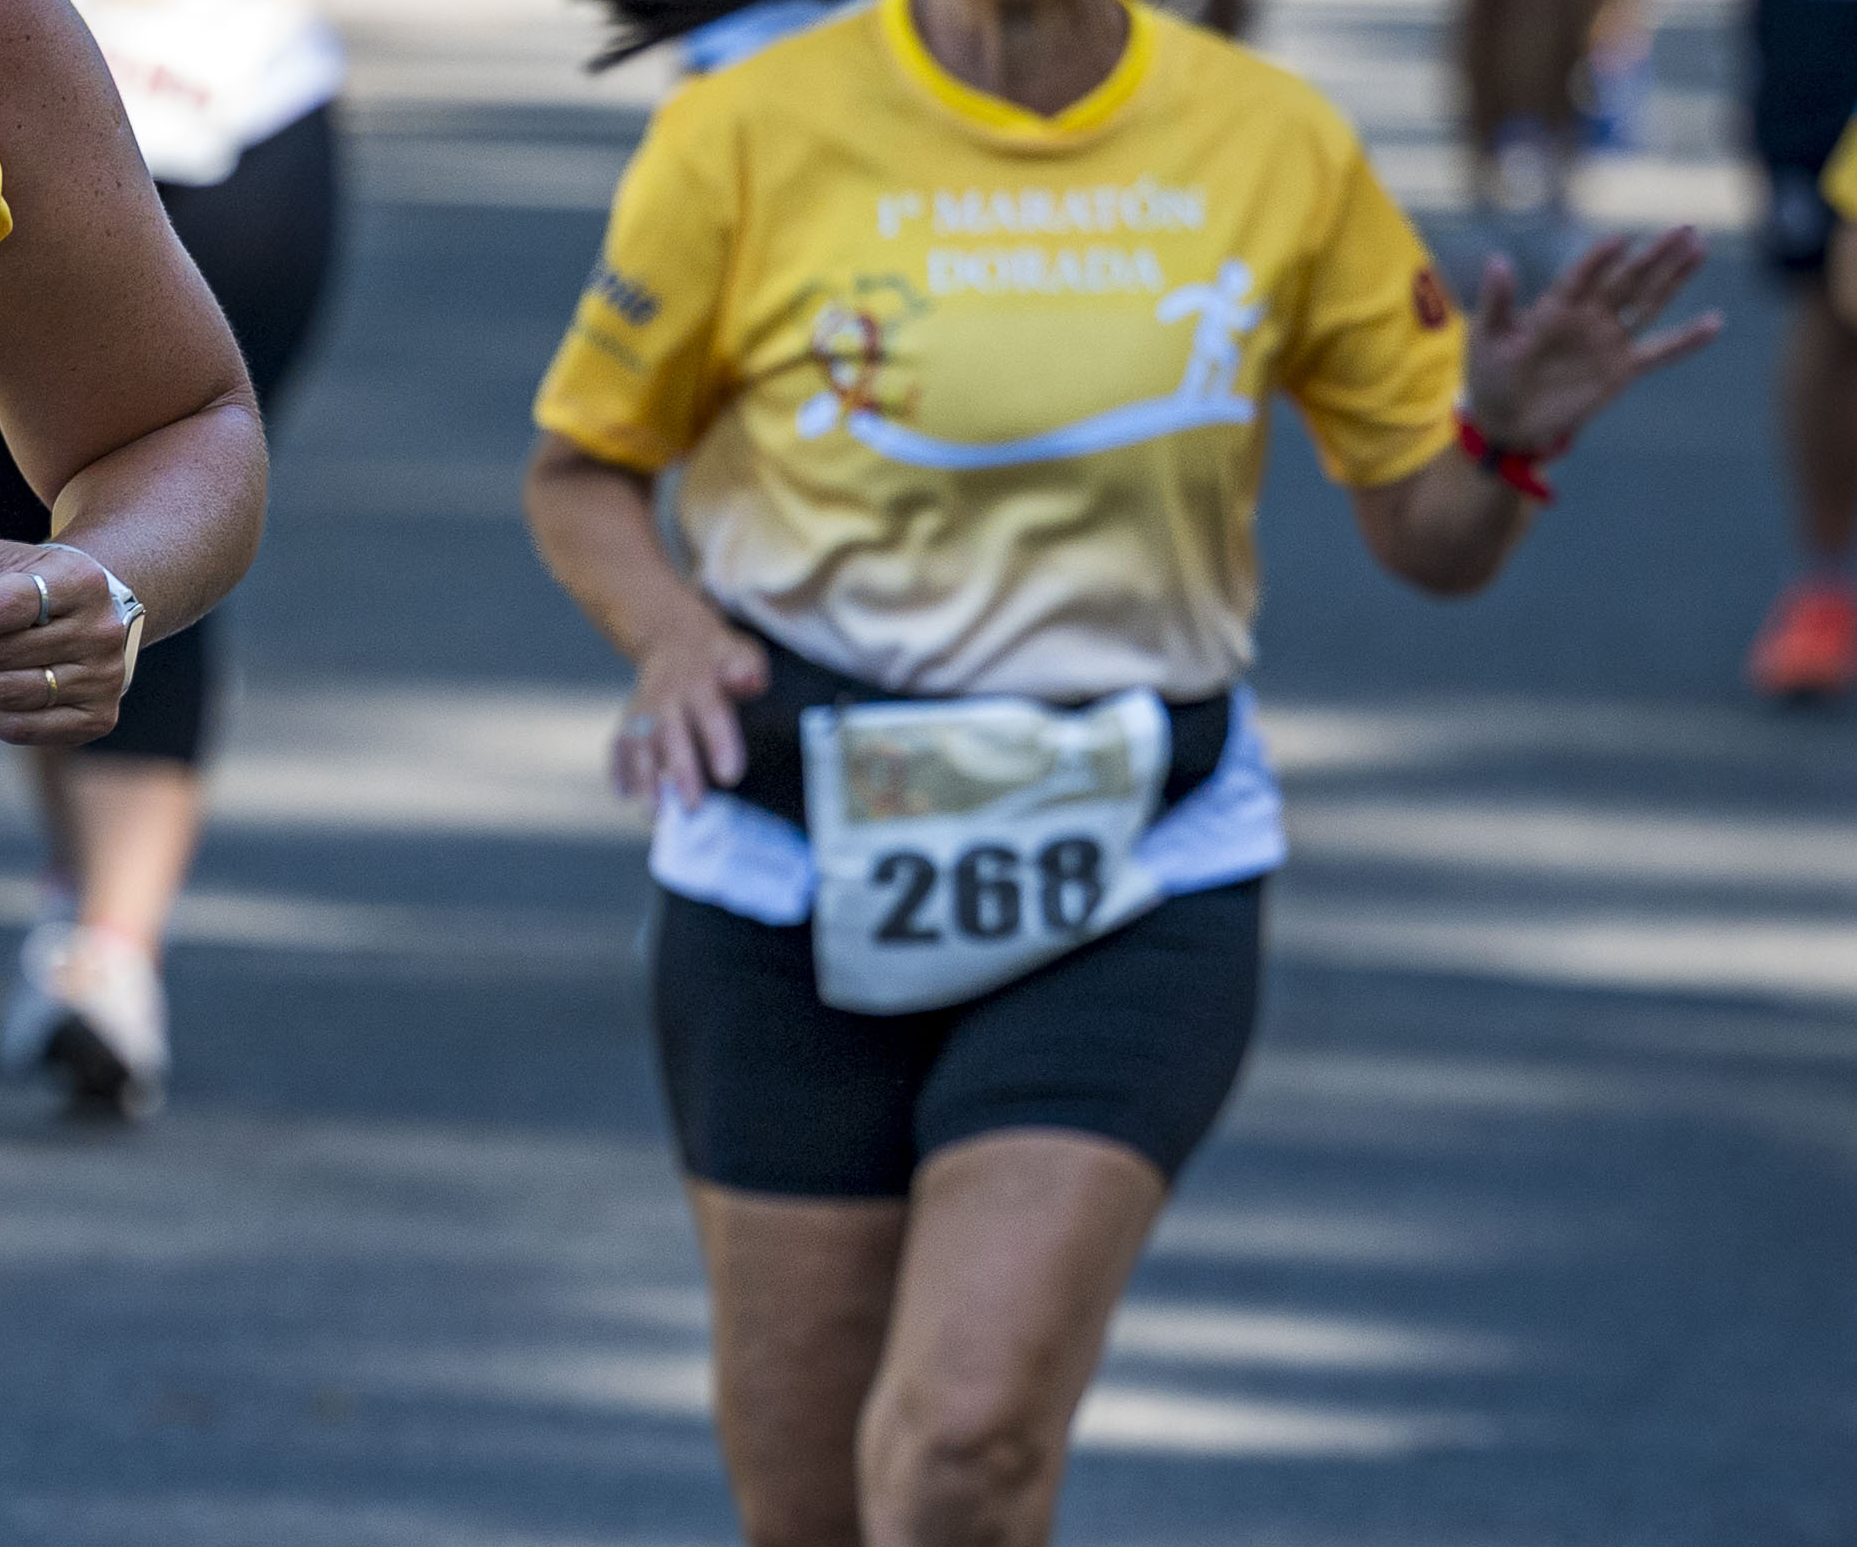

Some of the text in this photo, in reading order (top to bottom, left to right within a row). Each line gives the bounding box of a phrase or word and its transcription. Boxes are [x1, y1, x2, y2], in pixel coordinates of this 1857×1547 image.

[932, 173, 1209, 234] MARATÓN
[926, 247, 1165, 294] DORADA
[867, 836, 1103, 944] 268
